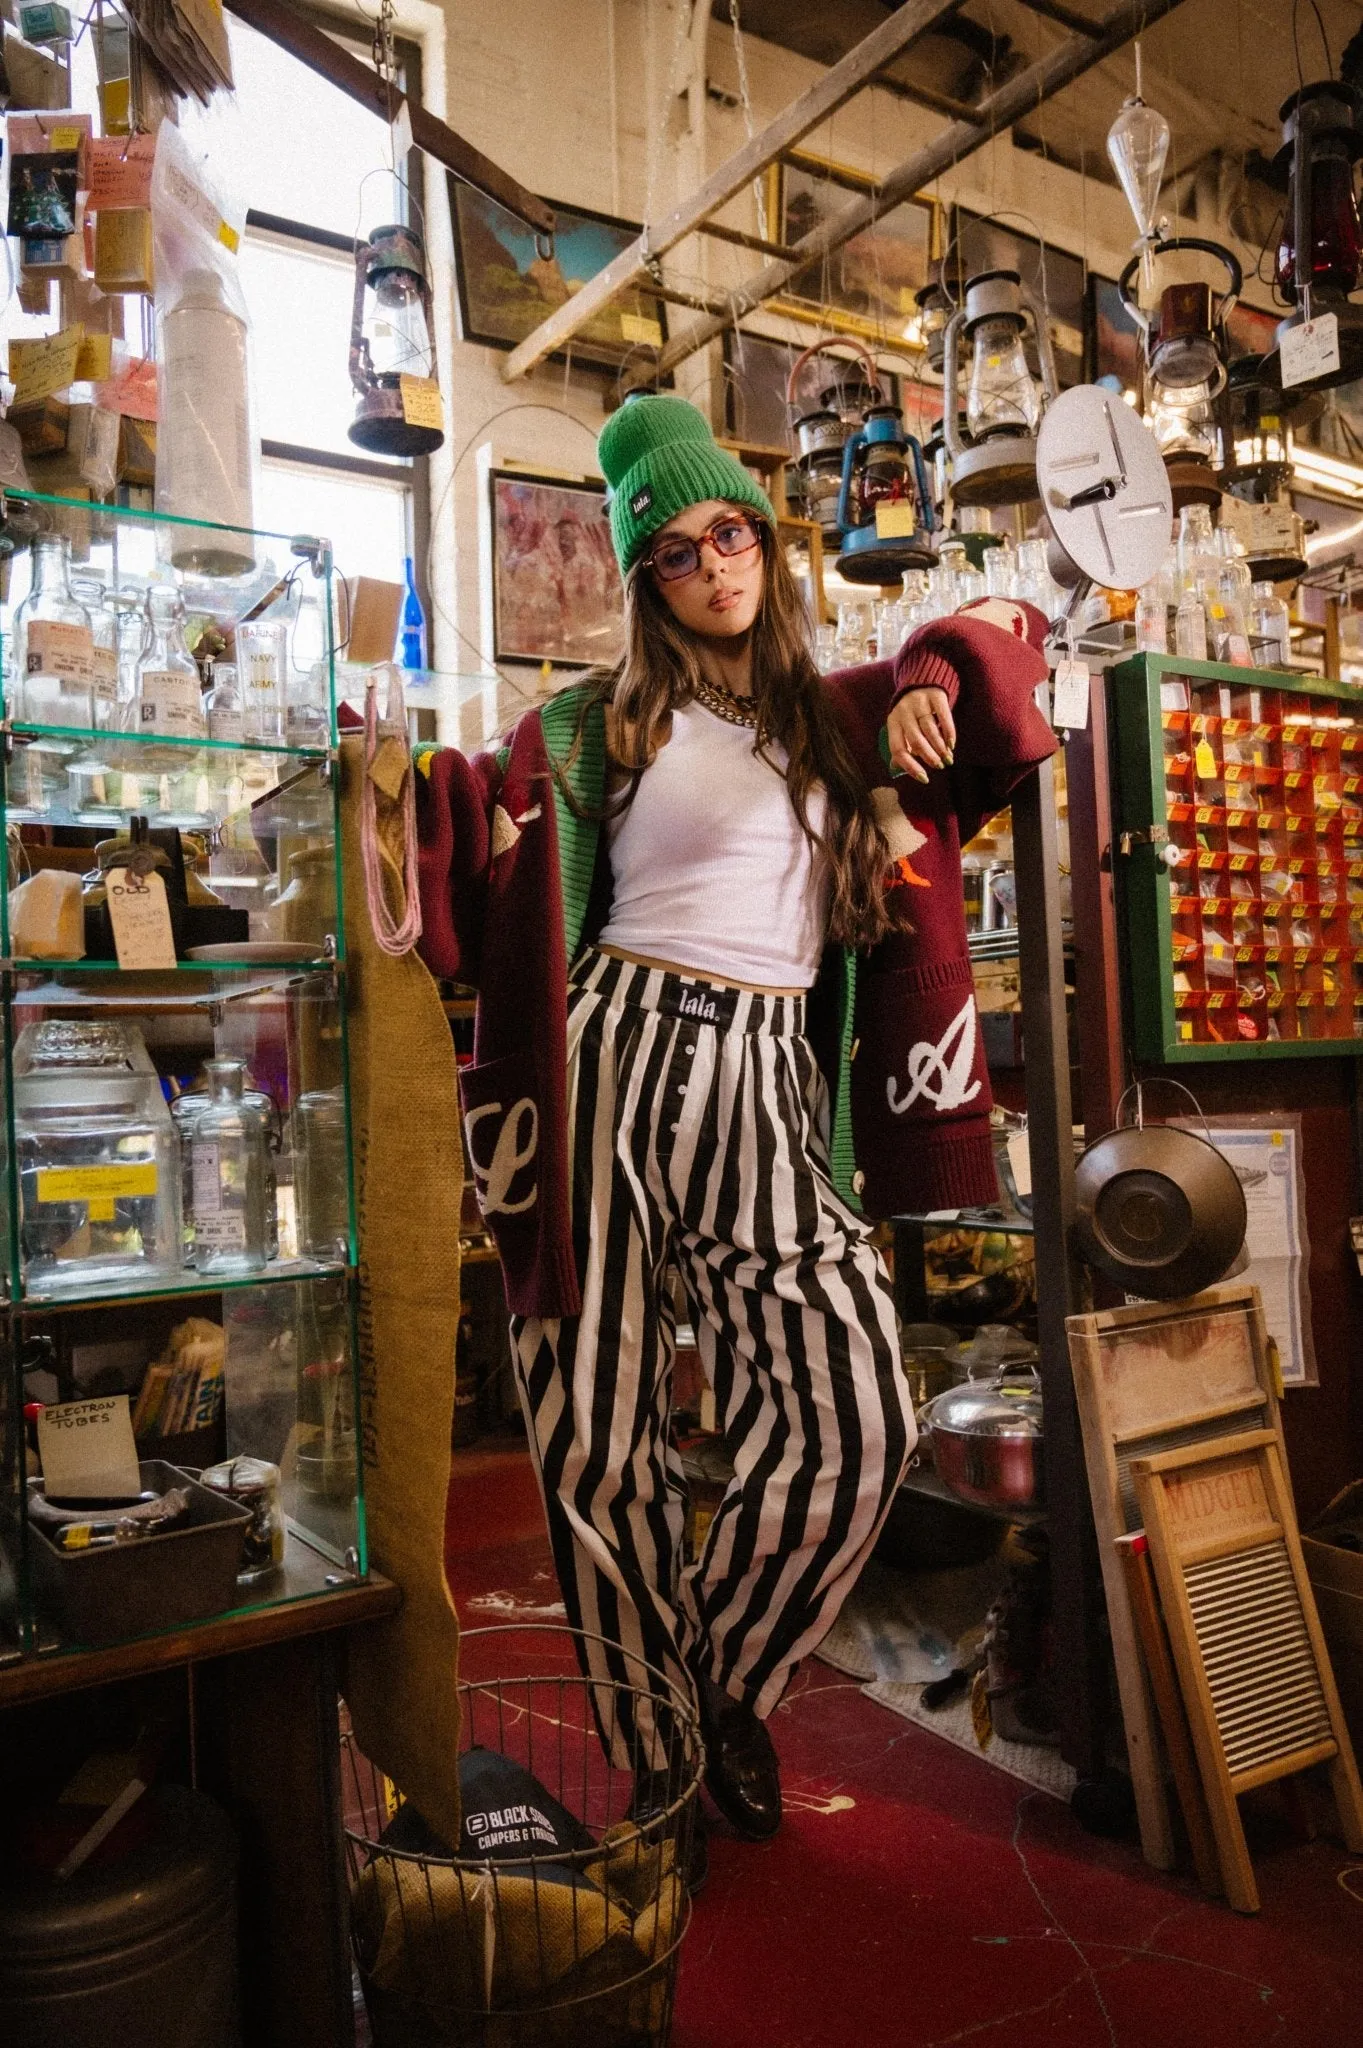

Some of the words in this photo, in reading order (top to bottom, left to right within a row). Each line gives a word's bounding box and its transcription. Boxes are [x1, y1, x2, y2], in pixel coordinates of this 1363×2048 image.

[250, 654, 277, 663] NAVY
[112, 885, 150, 896] OLD
[45, 1401, 116, 1421] ELECTRON
[50, 1413, 110, 1430] TUBES
[1163, 1468, 1258, 1523] MIDGET
[488, 1805, 530, 1829] BLACK
[478, 1829, 521, 1849] CAMPERS
